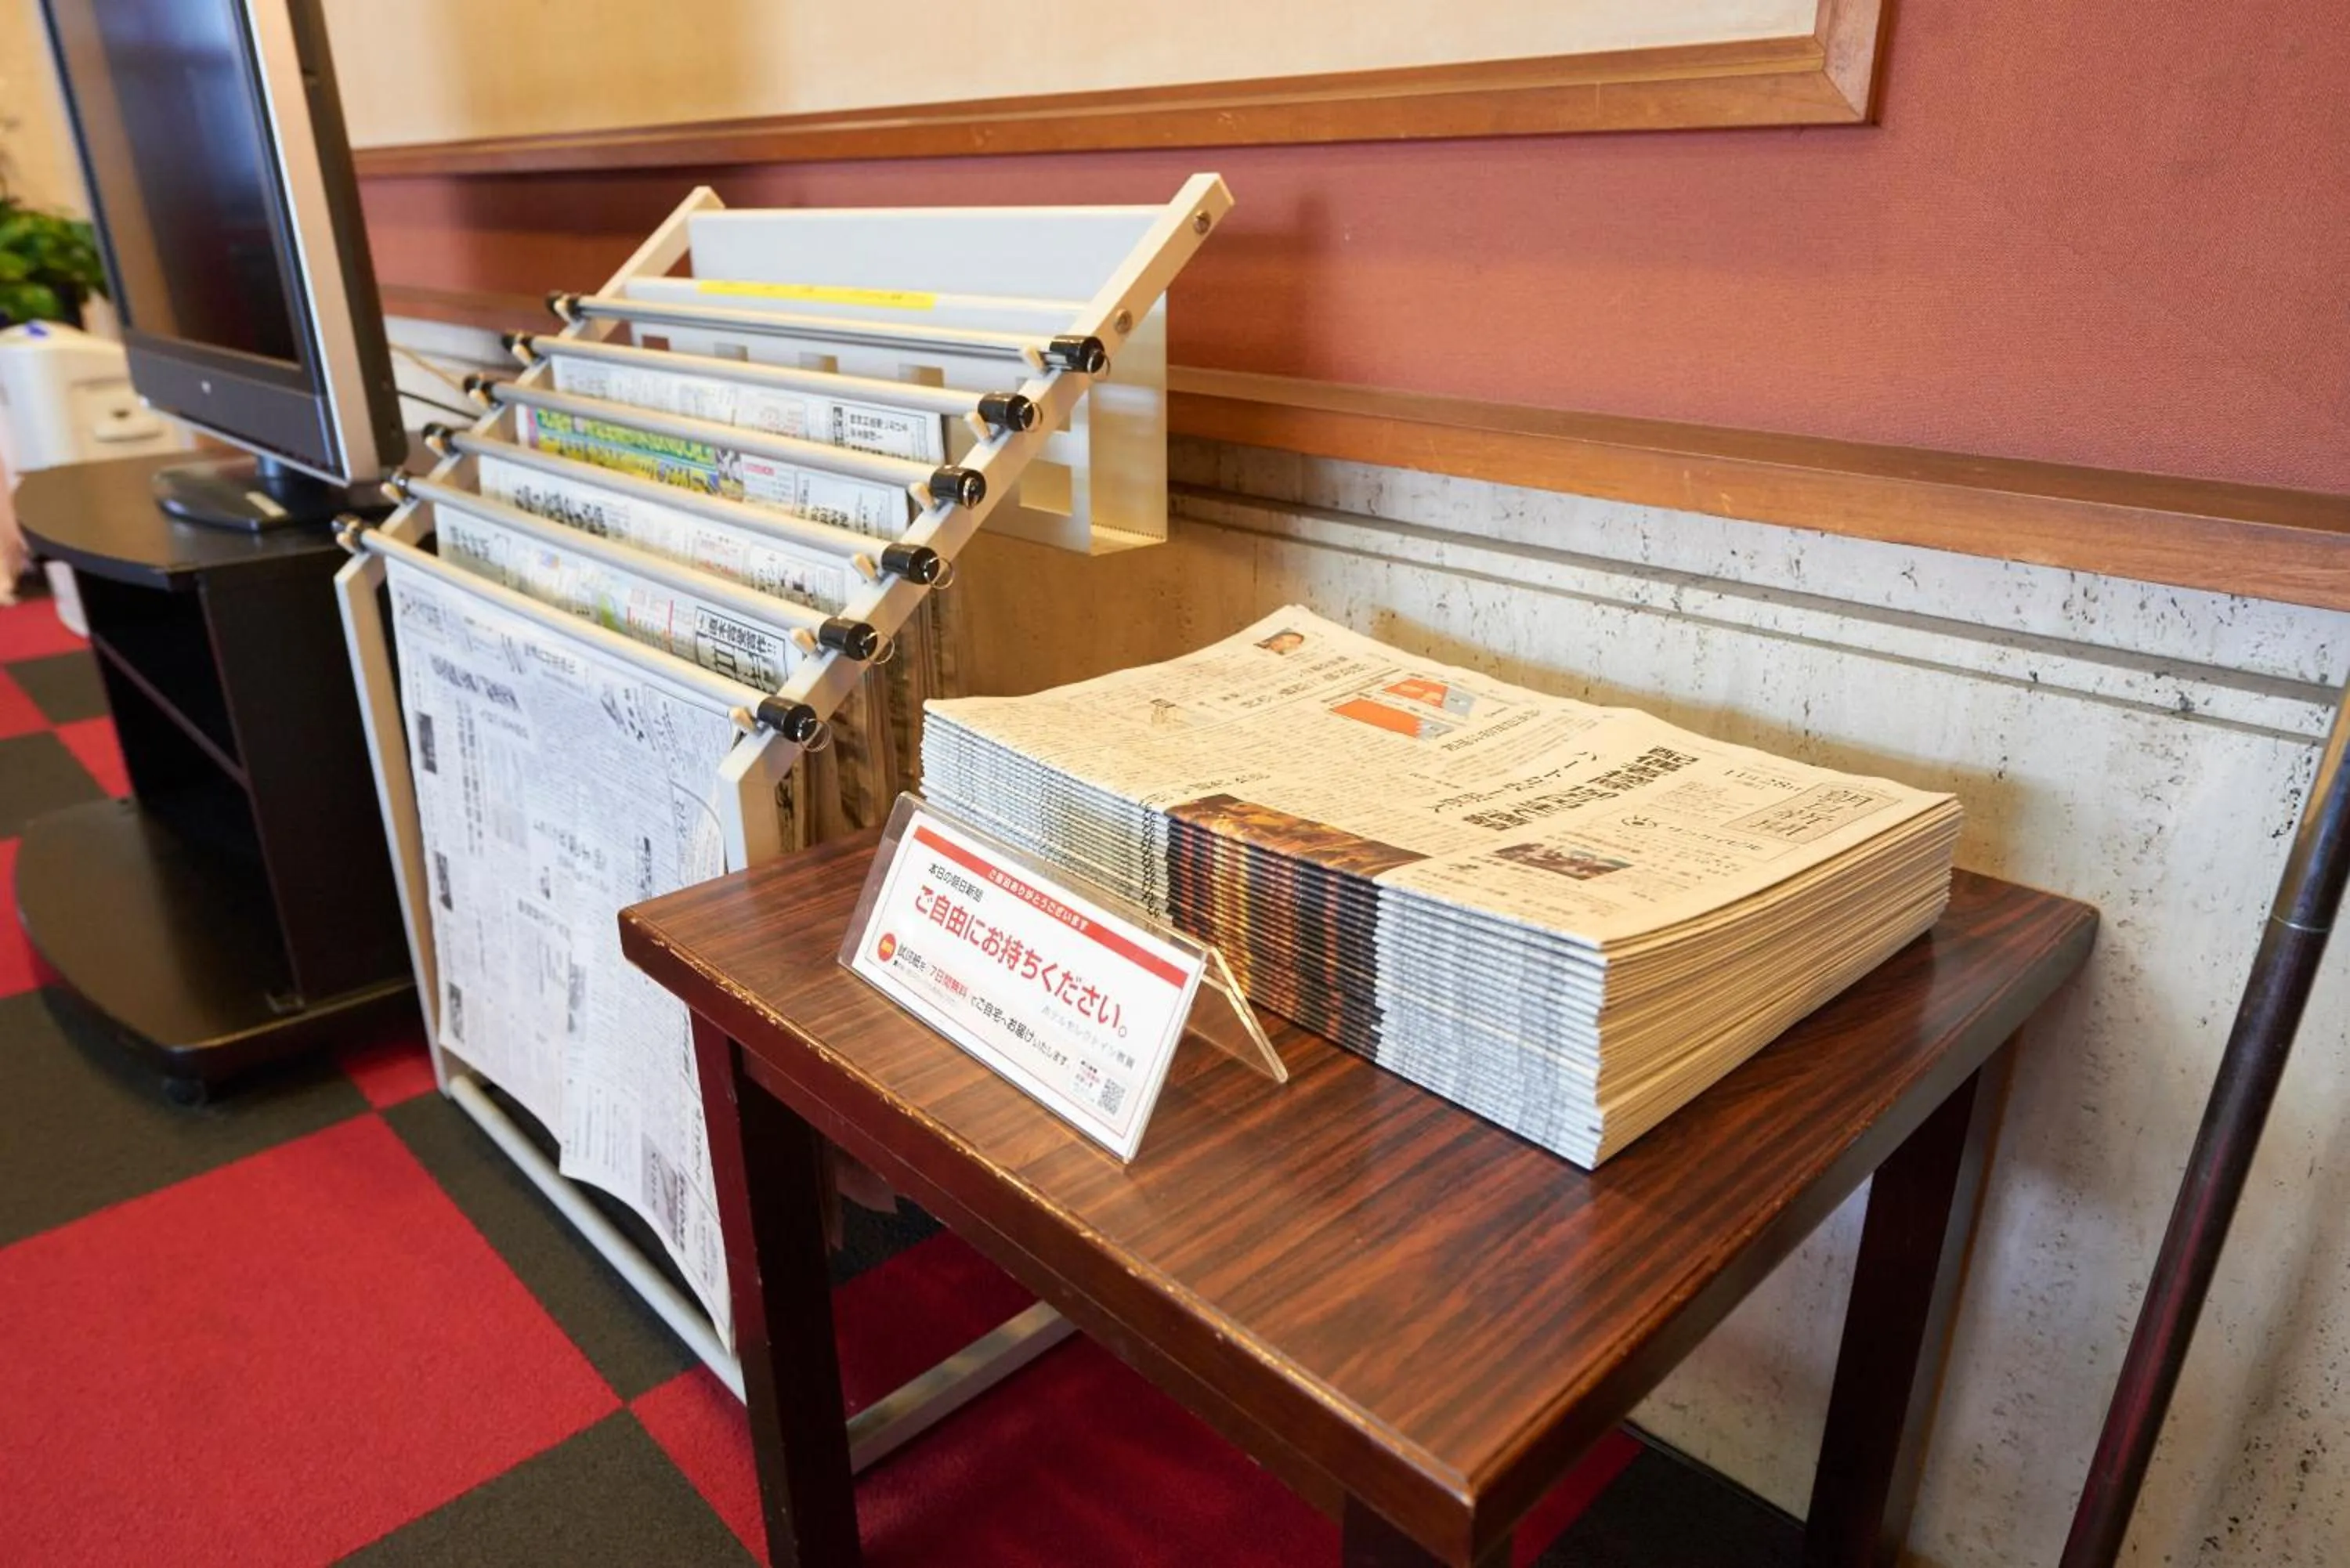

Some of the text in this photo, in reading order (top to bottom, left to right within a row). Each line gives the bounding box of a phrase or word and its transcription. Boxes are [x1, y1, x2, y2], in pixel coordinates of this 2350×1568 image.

[927, 862, 985, 902] 本日の朝日新聞
[914, 884, 1127, 1037] ご自由にお持ちください。
